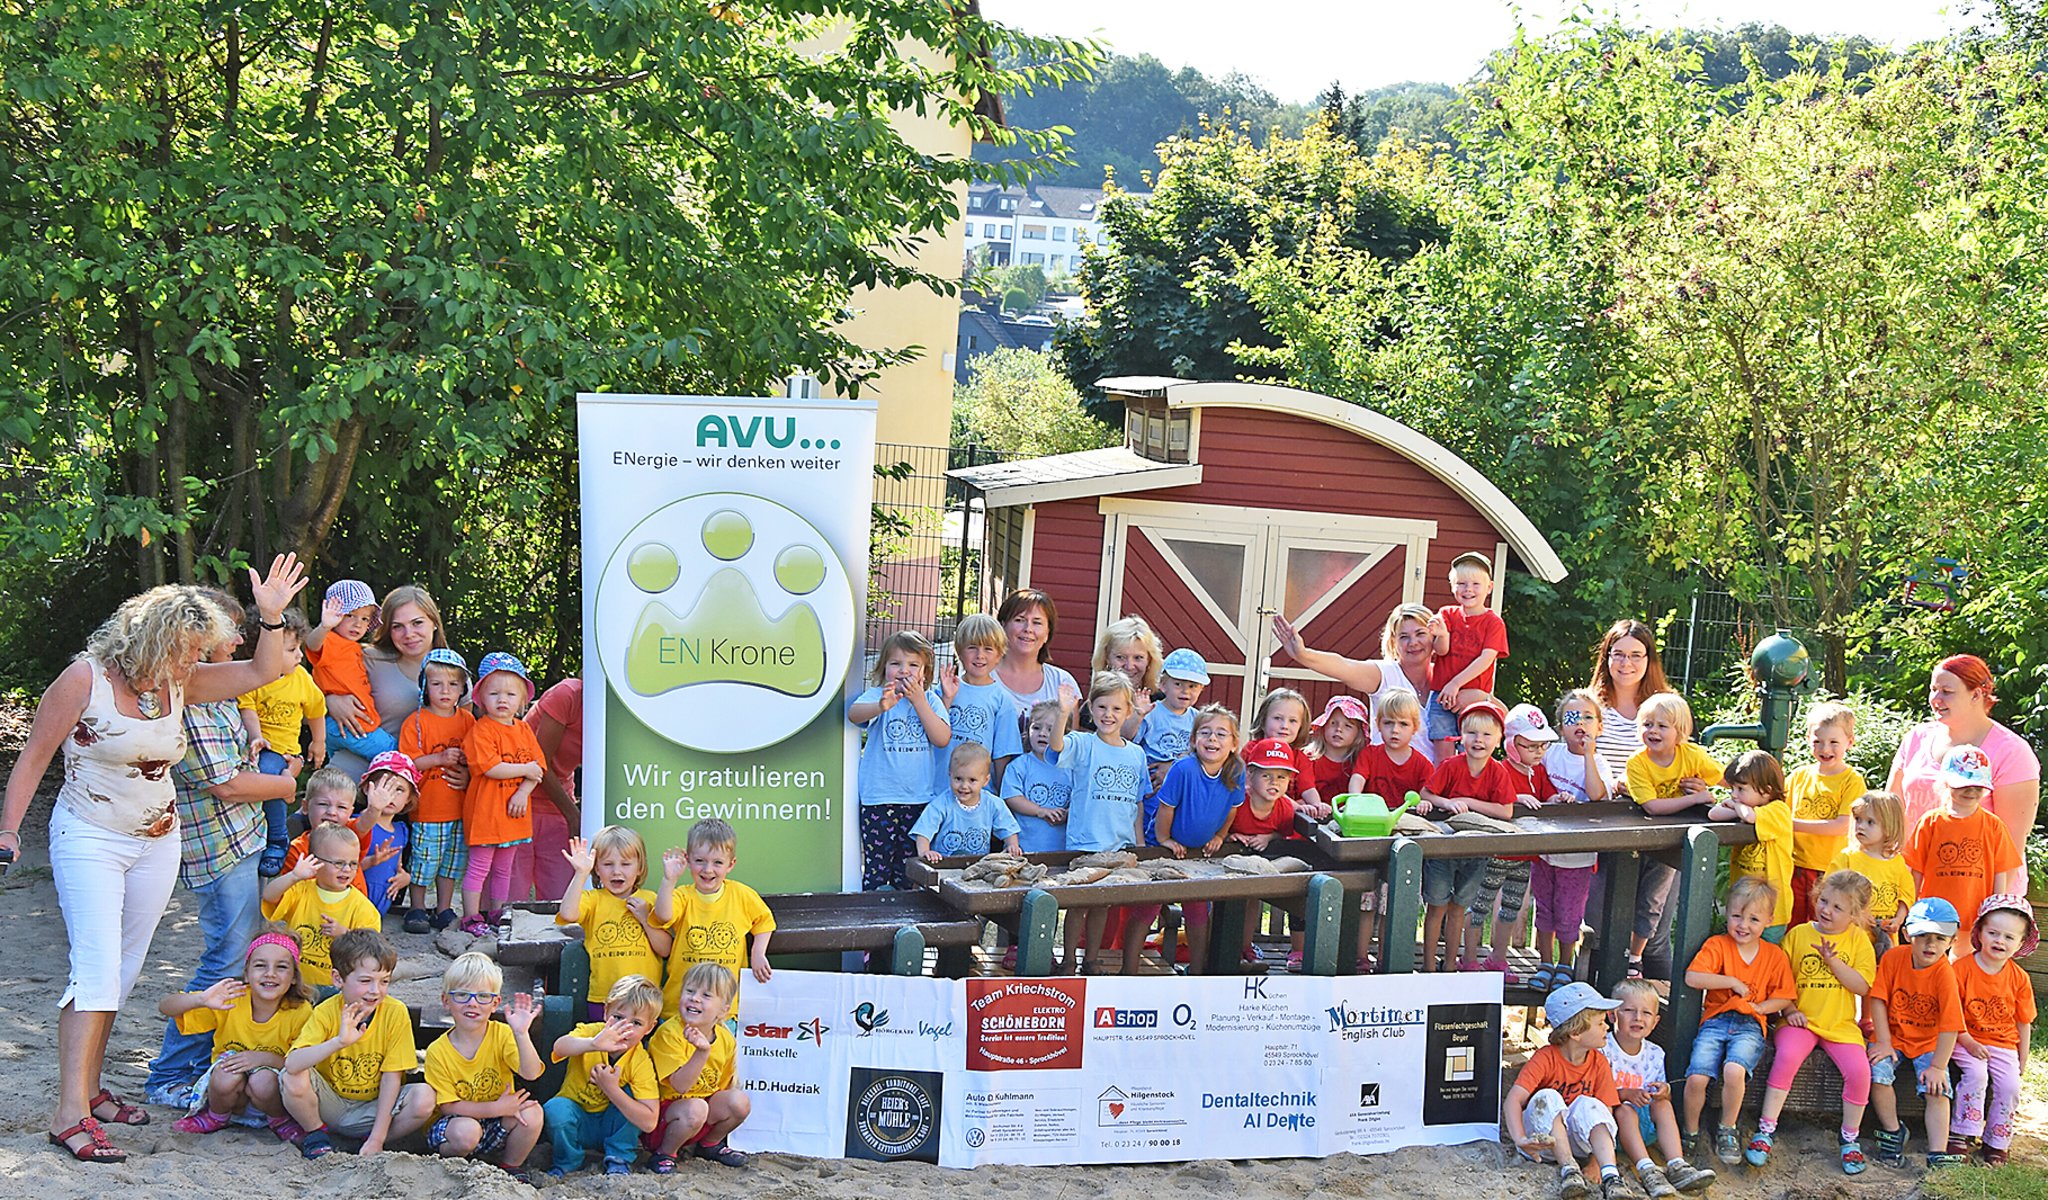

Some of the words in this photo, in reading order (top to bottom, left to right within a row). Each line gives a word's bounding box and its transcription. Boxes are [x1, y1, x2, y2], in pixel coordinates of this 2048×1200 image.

[612, 451, 678, 468] ENergie
[696, 454, 722, 468] wir
[727, 454, 785, 469] denken
[790, 455, 841, 471] weiter
[659, 637, 700, 664] EN
[711, 638, 795, 666] Krone
[1266, 750, 1289, 760] DEKRA
[623, 763, 671, 787] Wir
[679, 765, 825, 791] gratulieren
[615, 797, 664, 819] den
[675, 797, 832, 820] Gewinnern!
[970, 989, 1003, 1012] Team
[1005, 982, 1076, 1009] Kriechstrom
[1033, 1006, 1066, 1014] ELEKTRO
[1211, 1014, 1240, 1022] Planung
[1246, 1013, 1274, 1021] Verkauf
[1279, 1013, 1310, 1022] Montage
[1325, 999, 1424, 1033] Mortimer
[980, 1014, 1065, 1030] SCHÖNEBORN
[1205, 1024, 1259, 1032] Modernisierung
[1265, 1023, 1321, 1032] Küchenumzüge
[1434, 1021, 1488, 1031] Fliesenfachgeschäft
[743, 1022, 793, 1039] star
[918, 1020, 953, 1042] Vogel
[1342, 1027, 1379, 1043] English
[1382, 1027, 1405, 1038] Club
[1452, 1034, 1469, 1042] Beyer
[742, 1045, 798, 1059] Tankstelle
[1028, 1046, 1068, 1065] Sprockhövel
[744, 1079, 821, 1095] H.D.Hudziak
[965, 1093, 986, 1102] Auto
[995, 1093, 1035, 1101] Kuhlmann
[1130, 1091, 1175, 1100] Hilgenstock
[1202, 1091, 1317, 1109] Dentaltechnik
[878, 1110, 911, 1128] MÜHLE
[1243, 1113, 1261, 1129] Al
